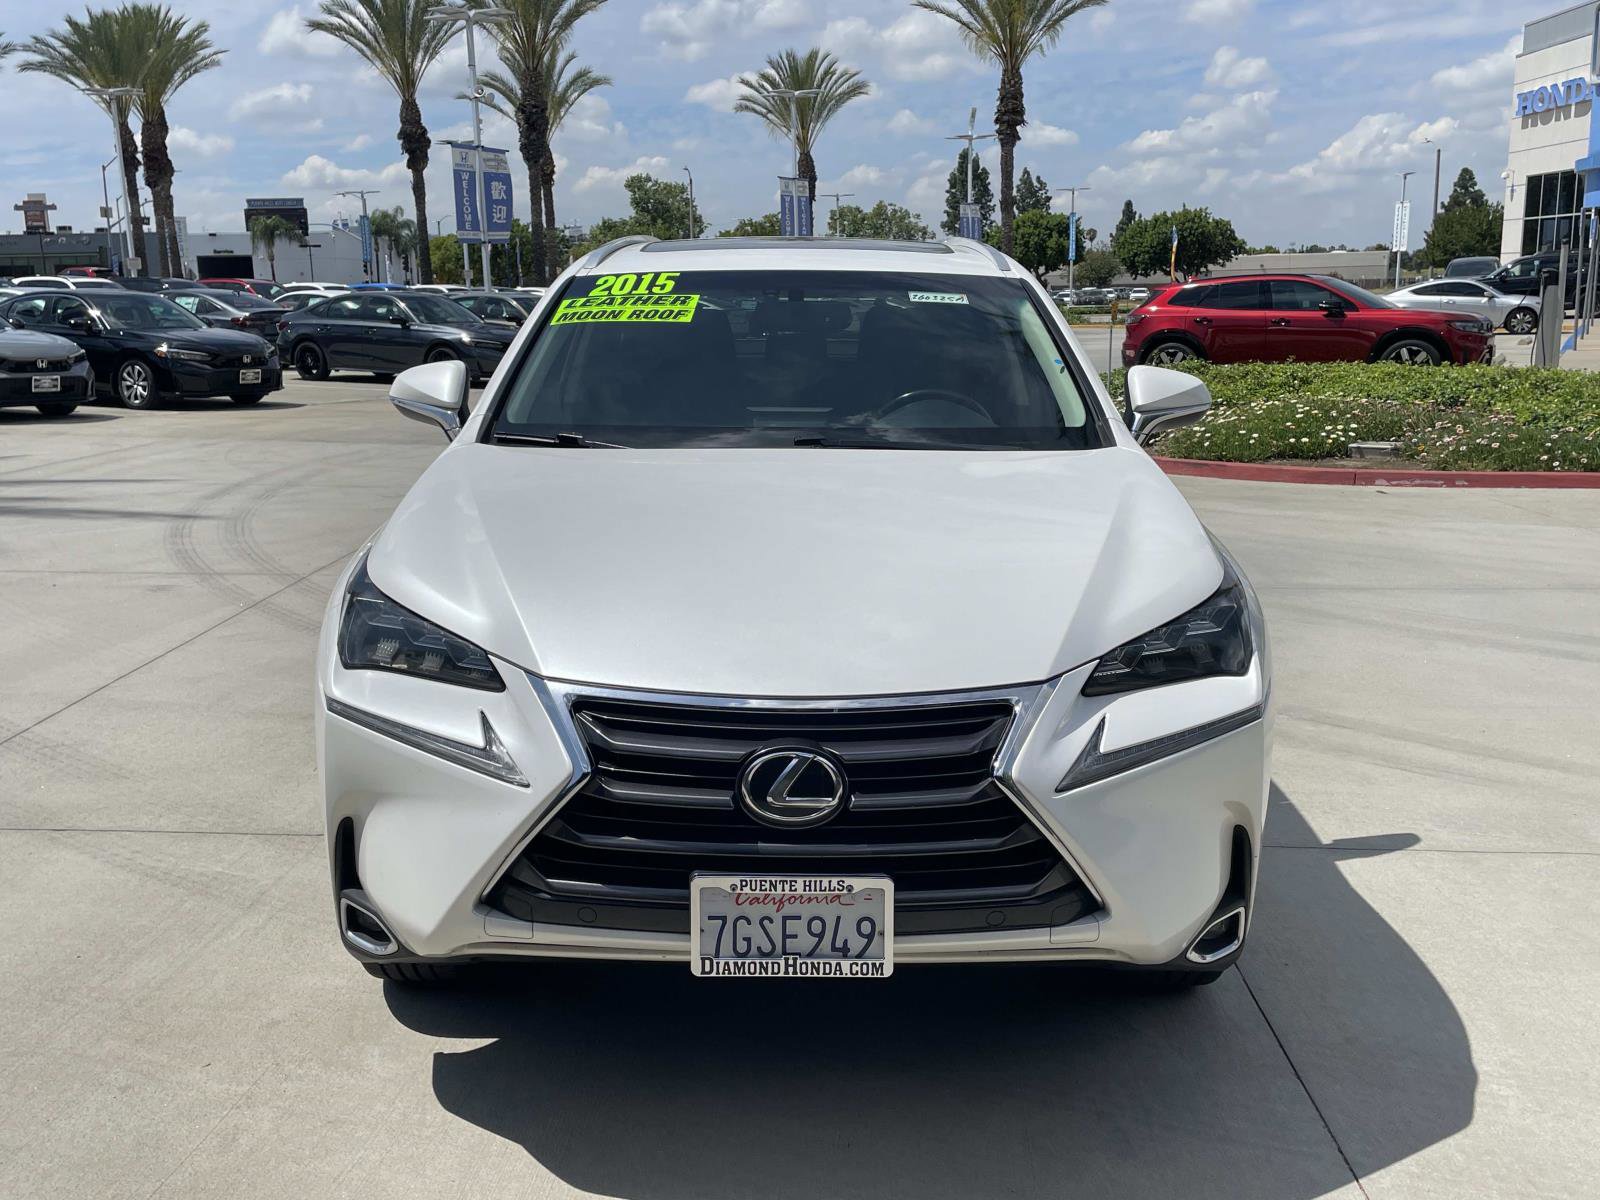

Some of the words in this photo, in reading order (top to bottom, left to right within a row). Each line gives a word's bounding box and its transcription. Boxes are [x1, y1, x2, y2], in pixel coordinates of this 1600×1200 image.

[1515, 76, 1593, 117] HOND
[460, 171, 472, 230] WELCOME
[588, 272, 681, 297] 2015
[563, 294, 693, 309] LEATHER
[555, 308, 627, 323] MOON
[627, 309, 690, 321] ROOF
[739, 879, 798, 893] PUENTE
[802, 879, 846, 893] HILLS
[735, 892, 855, 913] California
[707, 915, 877, 959] 7GSE949
